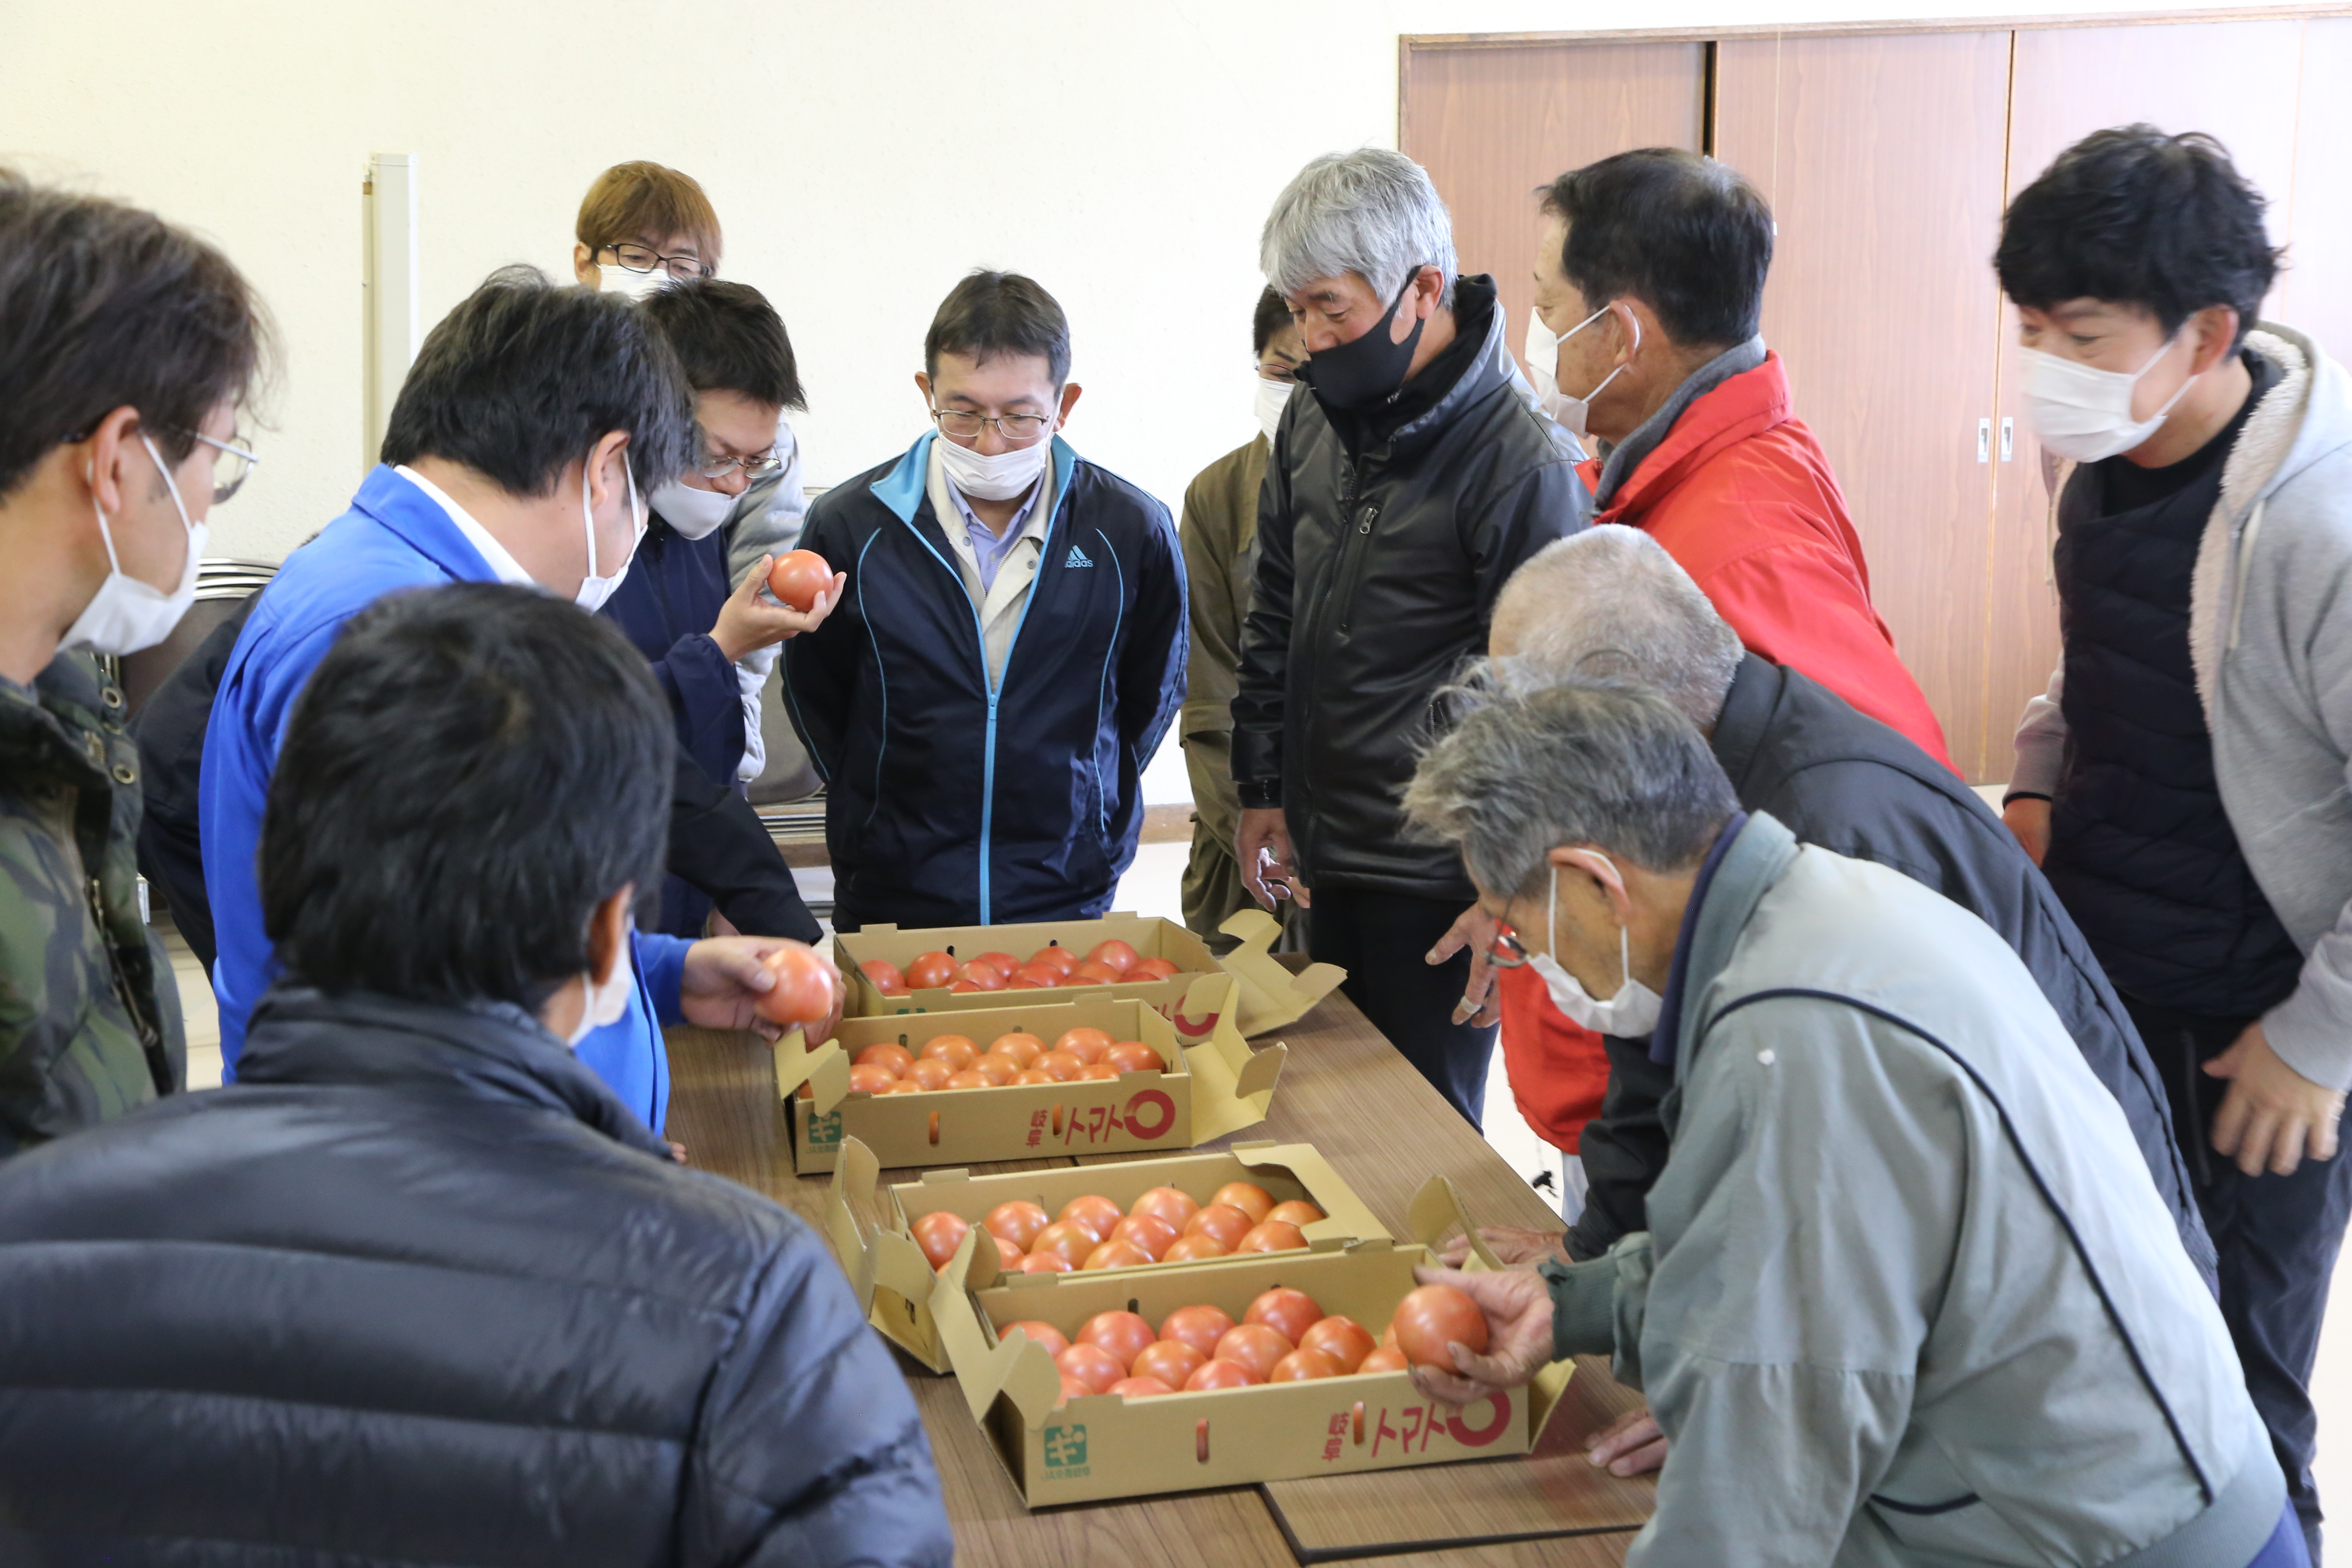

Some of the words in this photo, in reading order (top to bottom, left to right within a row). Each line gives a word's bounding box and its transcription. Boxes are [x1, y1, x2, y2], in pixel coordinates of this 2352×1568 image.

[1065, 1104, 1124, 1146] トマト
[1371, 1402, 1446, 1458] トマト
